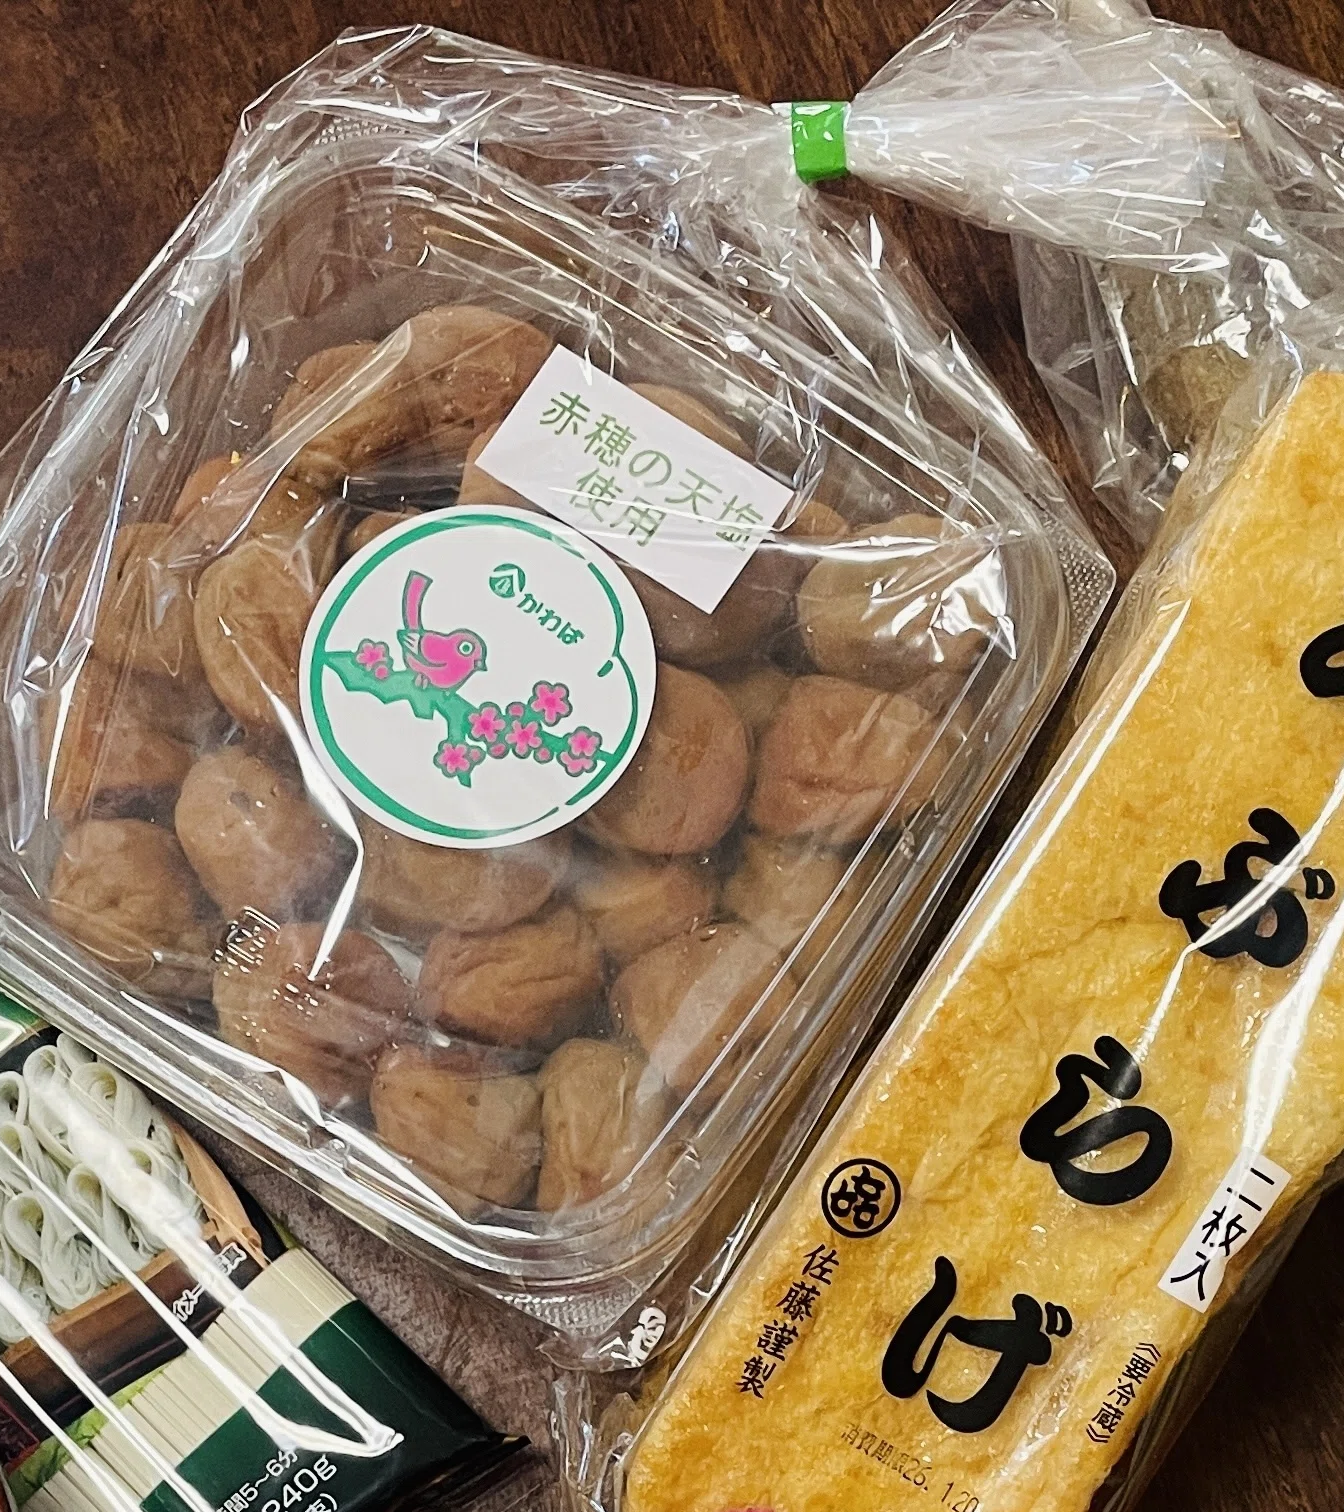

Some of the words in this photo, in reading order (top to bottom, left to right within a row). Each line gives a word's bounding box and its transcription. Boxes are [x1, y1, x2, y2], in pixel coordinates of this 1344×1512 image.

[539, 391, 765, 553] 赤穂の天塩
[568, 467, 670, 549] 使用
[517, 594, 589, 647] かわば
[1170, 1166, 1271, 1304] 二枚入
[734, 1242, 845, 1401] 佐藤謹製
